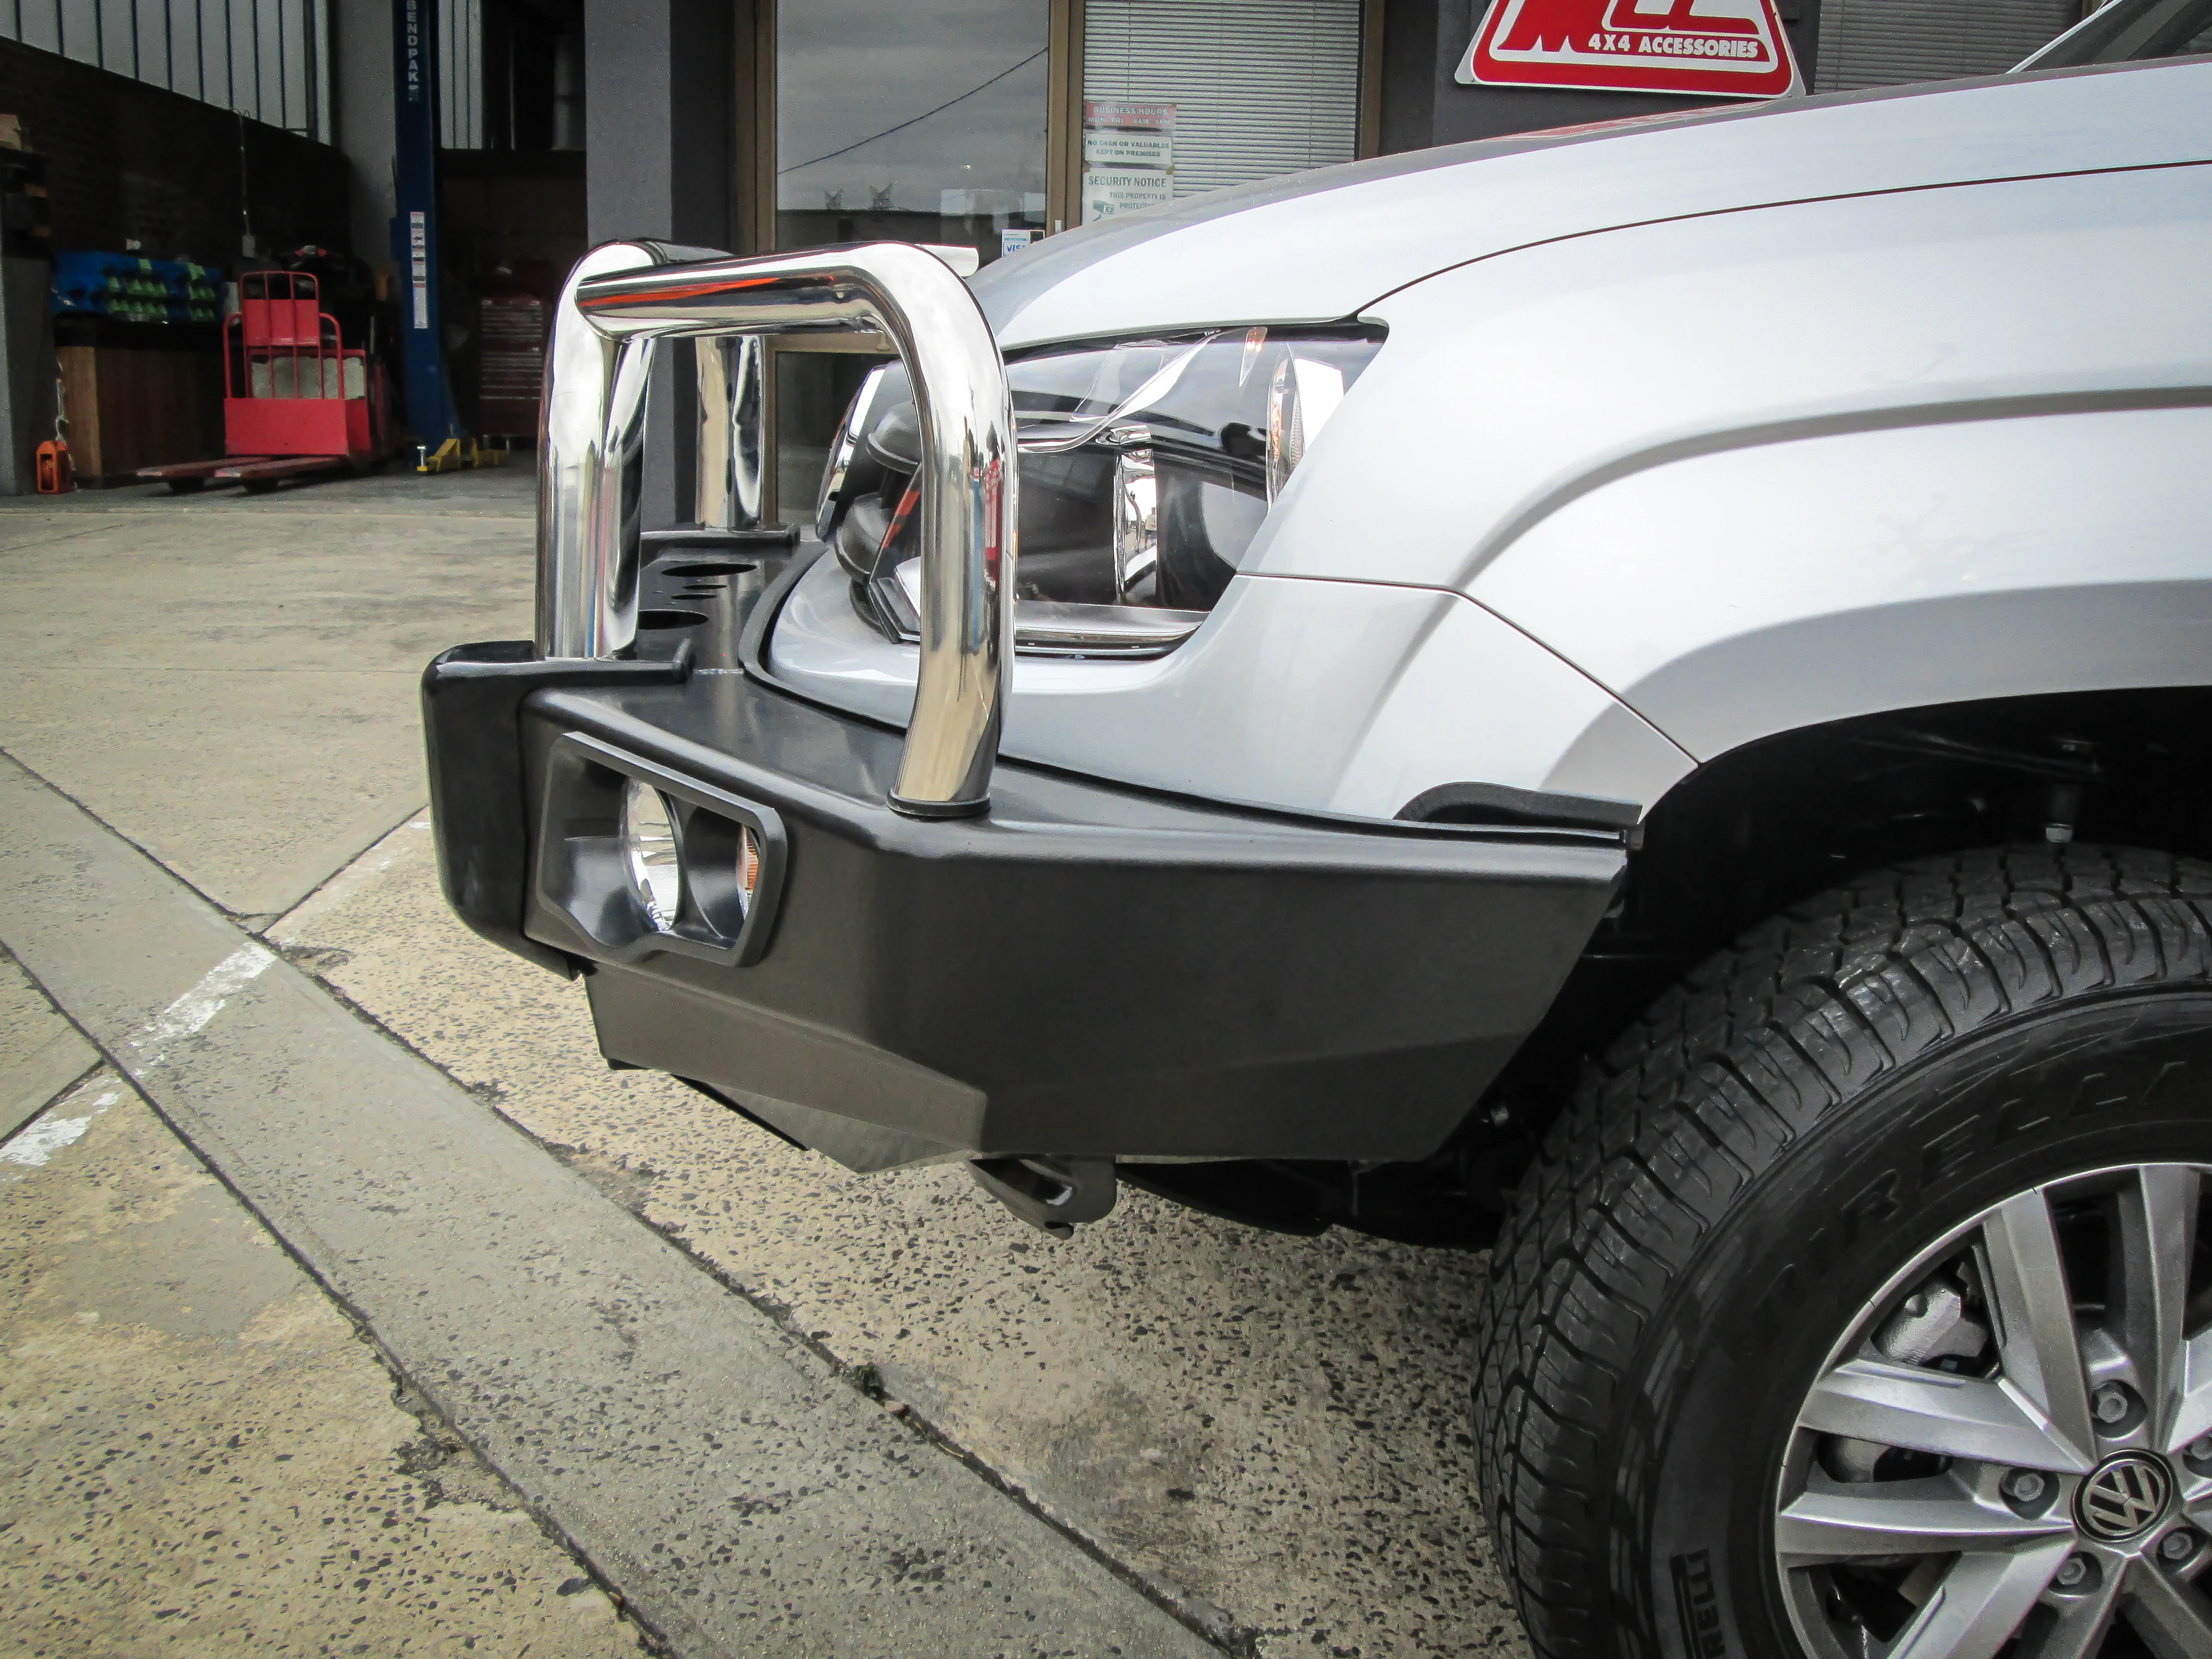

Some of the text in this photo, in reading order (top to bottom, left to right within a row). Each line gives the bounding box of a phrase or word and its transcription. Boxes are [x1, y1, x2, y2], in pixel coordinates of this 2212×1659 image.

[1588, 33, 1759, 58] 4X4 ACCESSORIES
[1093, 106, 1136, 114] BUSINESS
[1088, 176, 1167, 187] SECURITY NOTICE
